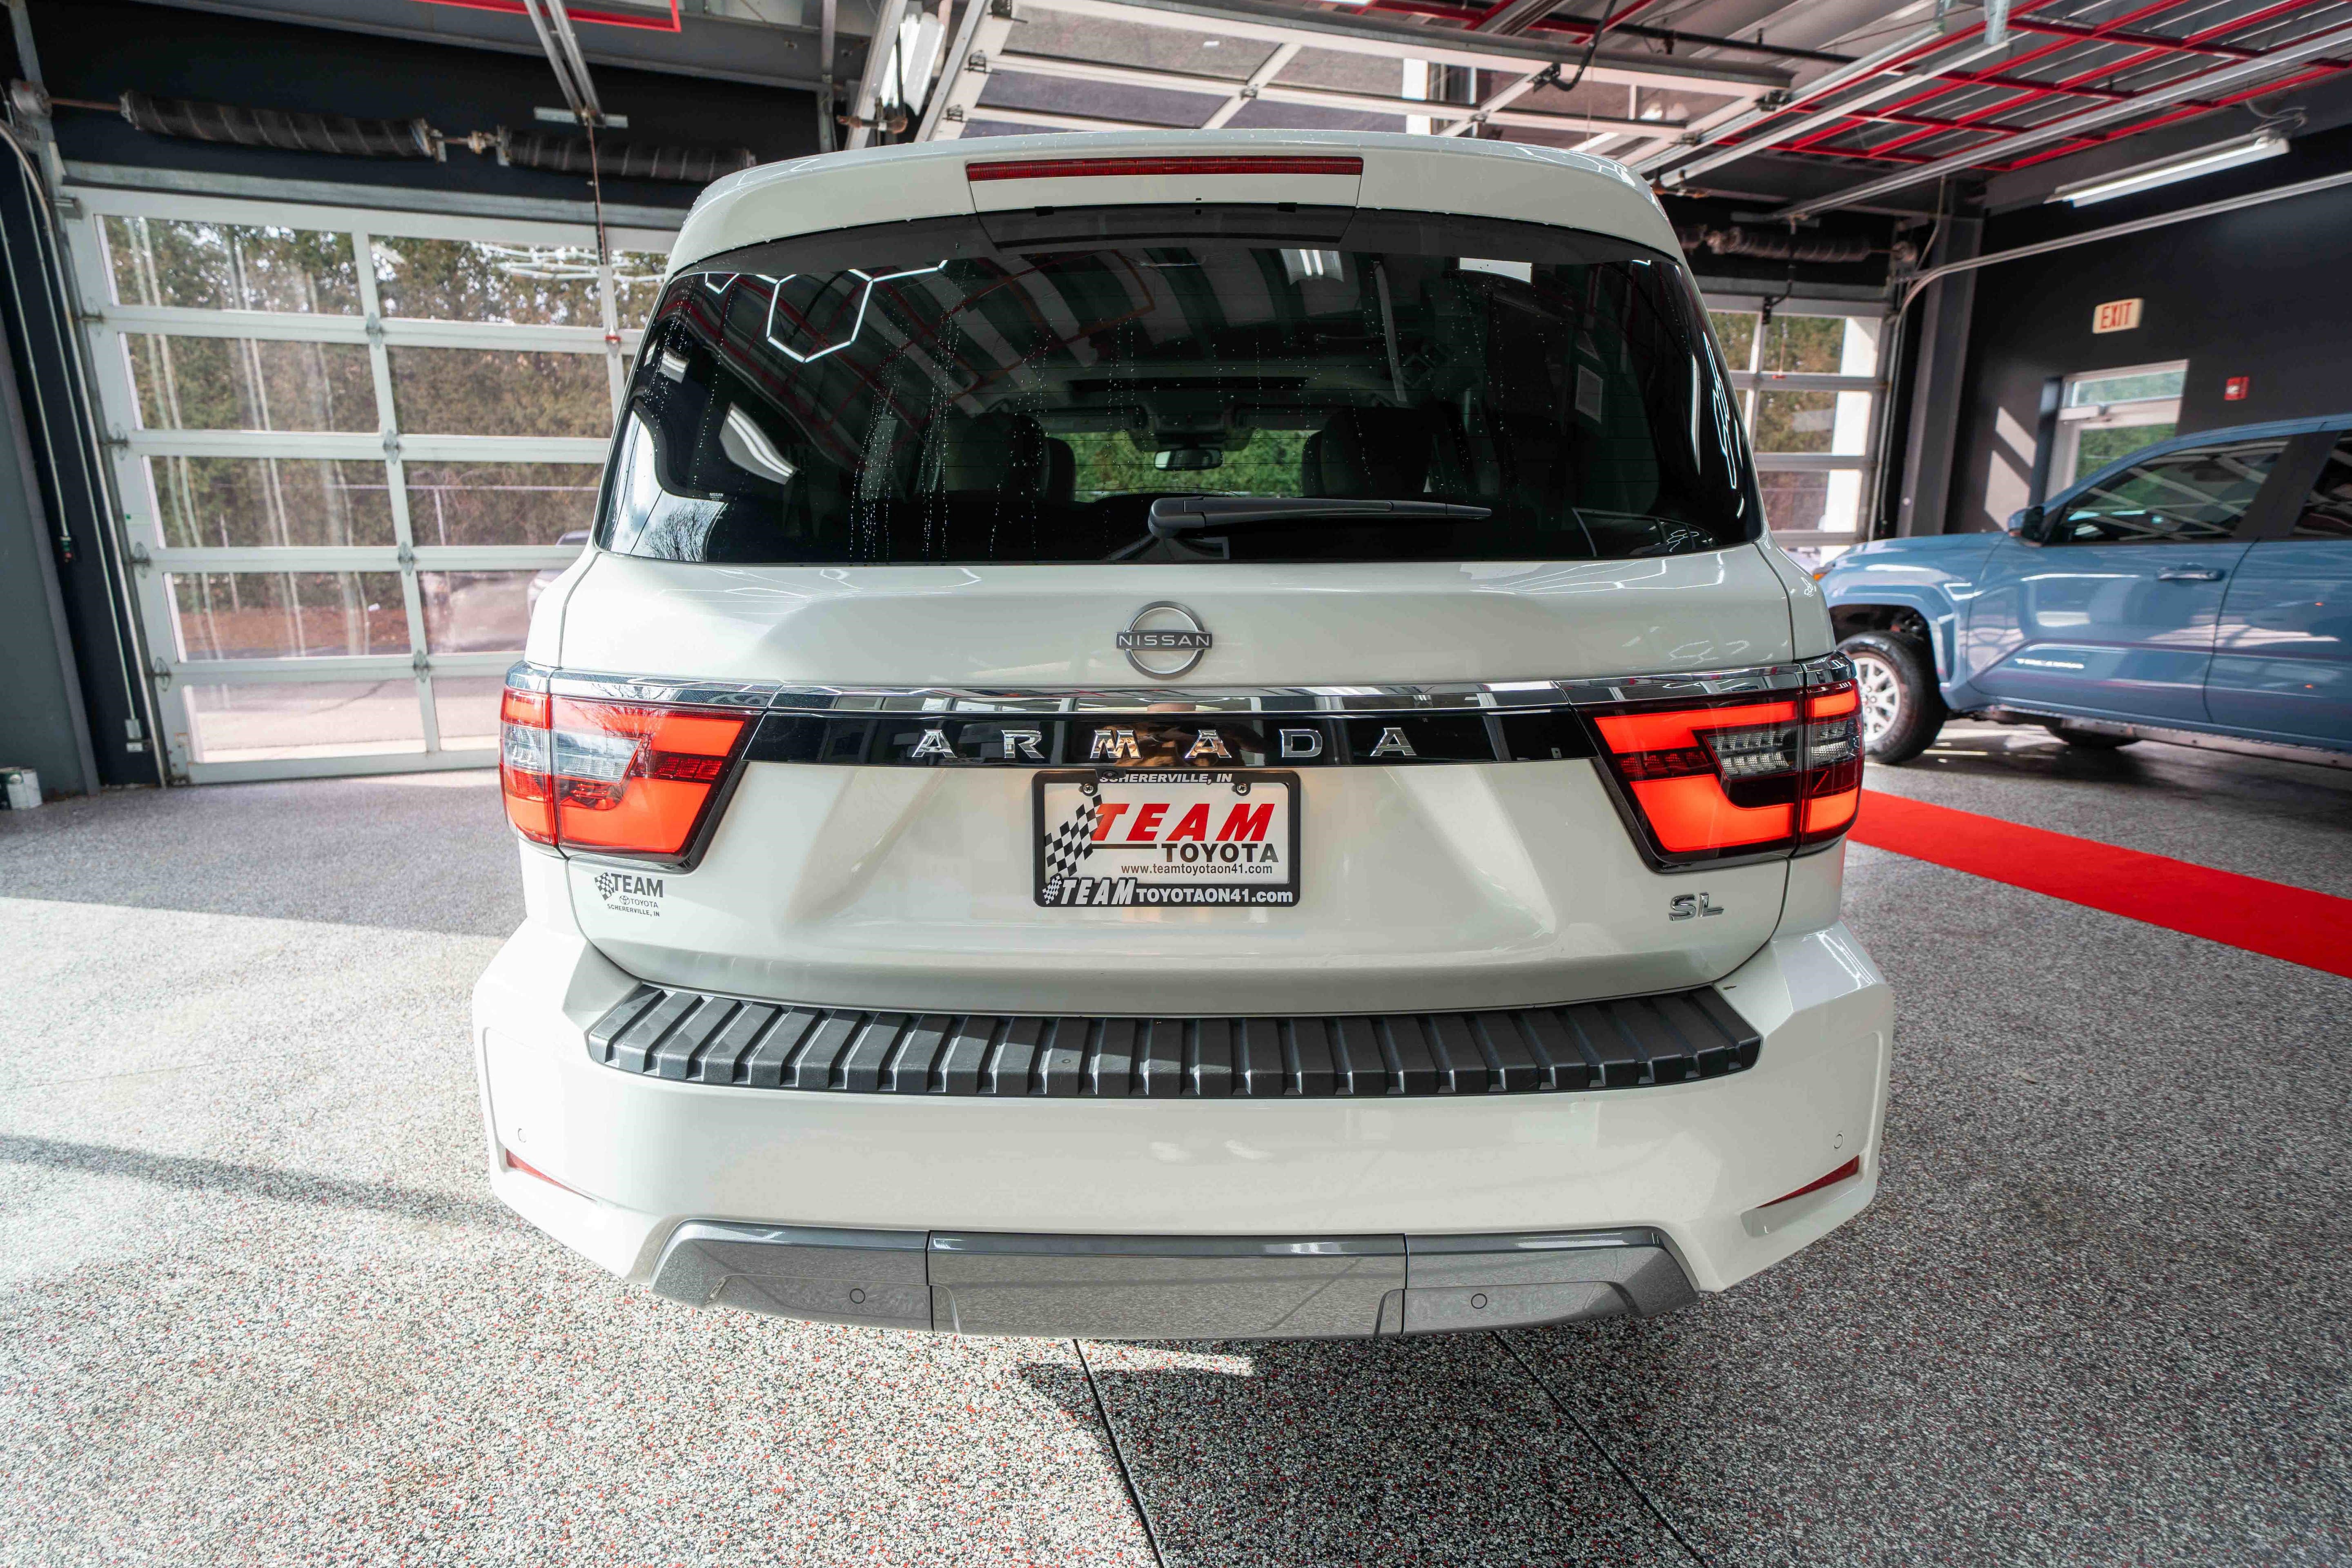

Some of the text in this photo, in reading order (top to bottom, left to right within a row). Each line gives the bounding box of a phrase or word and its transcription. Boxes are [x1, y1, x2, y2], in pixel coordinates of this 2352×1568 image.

[2100, 302, 2132, 330] EXIT
[1119, 635, 1209, 646] NISSAN
[911, 727, 1417, 759] ARMADA
[1216, 773, 1233, 782] IN
[1091, 803, 1275, 841] TEAM
[1161, 843, 1279, 863] TOYOTA
[1121, 864, 1272, 876] www.teamtoyotaon41.com
[611, 873, 664, 898] TEAM
[1061, 878, 1293, 905] TEAM TOYOTAON41.com
[607, 904, 652, 917] SCHERERVILLE,
[630, 898, 659, 908] TOYOTA
[1668, 892, 1724, 921] SL
